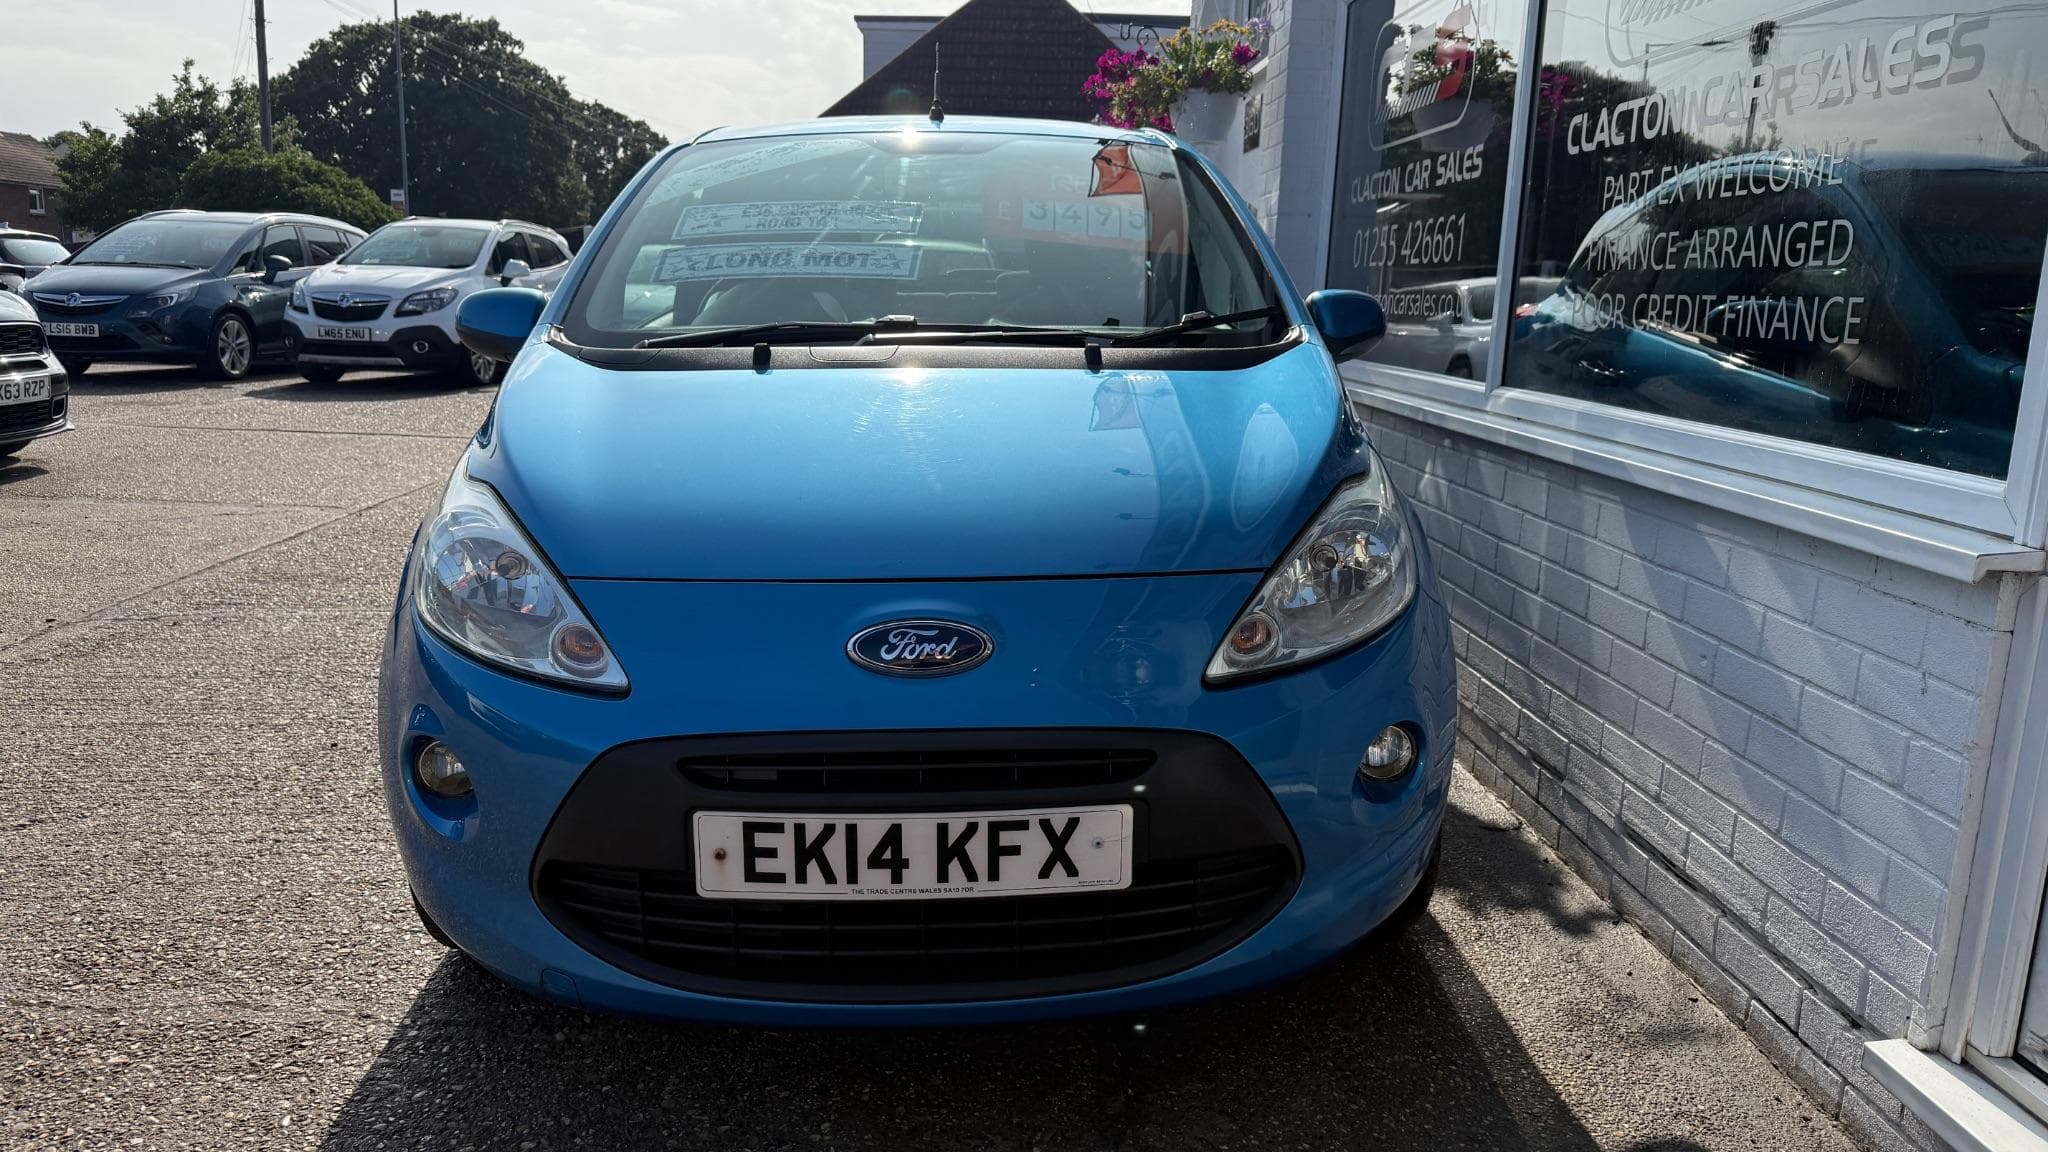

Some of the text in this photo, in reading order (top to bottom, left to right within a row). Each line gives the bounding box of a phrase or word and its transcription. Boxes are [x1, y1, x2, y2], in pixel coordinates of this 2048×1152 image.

[1567, 85, 1687, 155] CLACTON
[1352, 143, 1484, 203] CLACTON CAR SALES
[1602, 137, 1850, 211] PART EX WELCOME
[706, 252, 868, 270] LONG MOT
[1353, 212, 1466, 268] 01255 426661
[1586, 219, 1854, 271] FINANCE ARRANGED
[51, 324, 96, 335] LS15 BWB
[318, 327, 365, 339] LM65 ENU
[1570, 293, 1865, 345] POOR CREDIT FINANCE
[24, 379, 46, 398] RZP
[880, 628, 959, 661] Ford
[742, 816, 1081, 885] EK14 KFX
